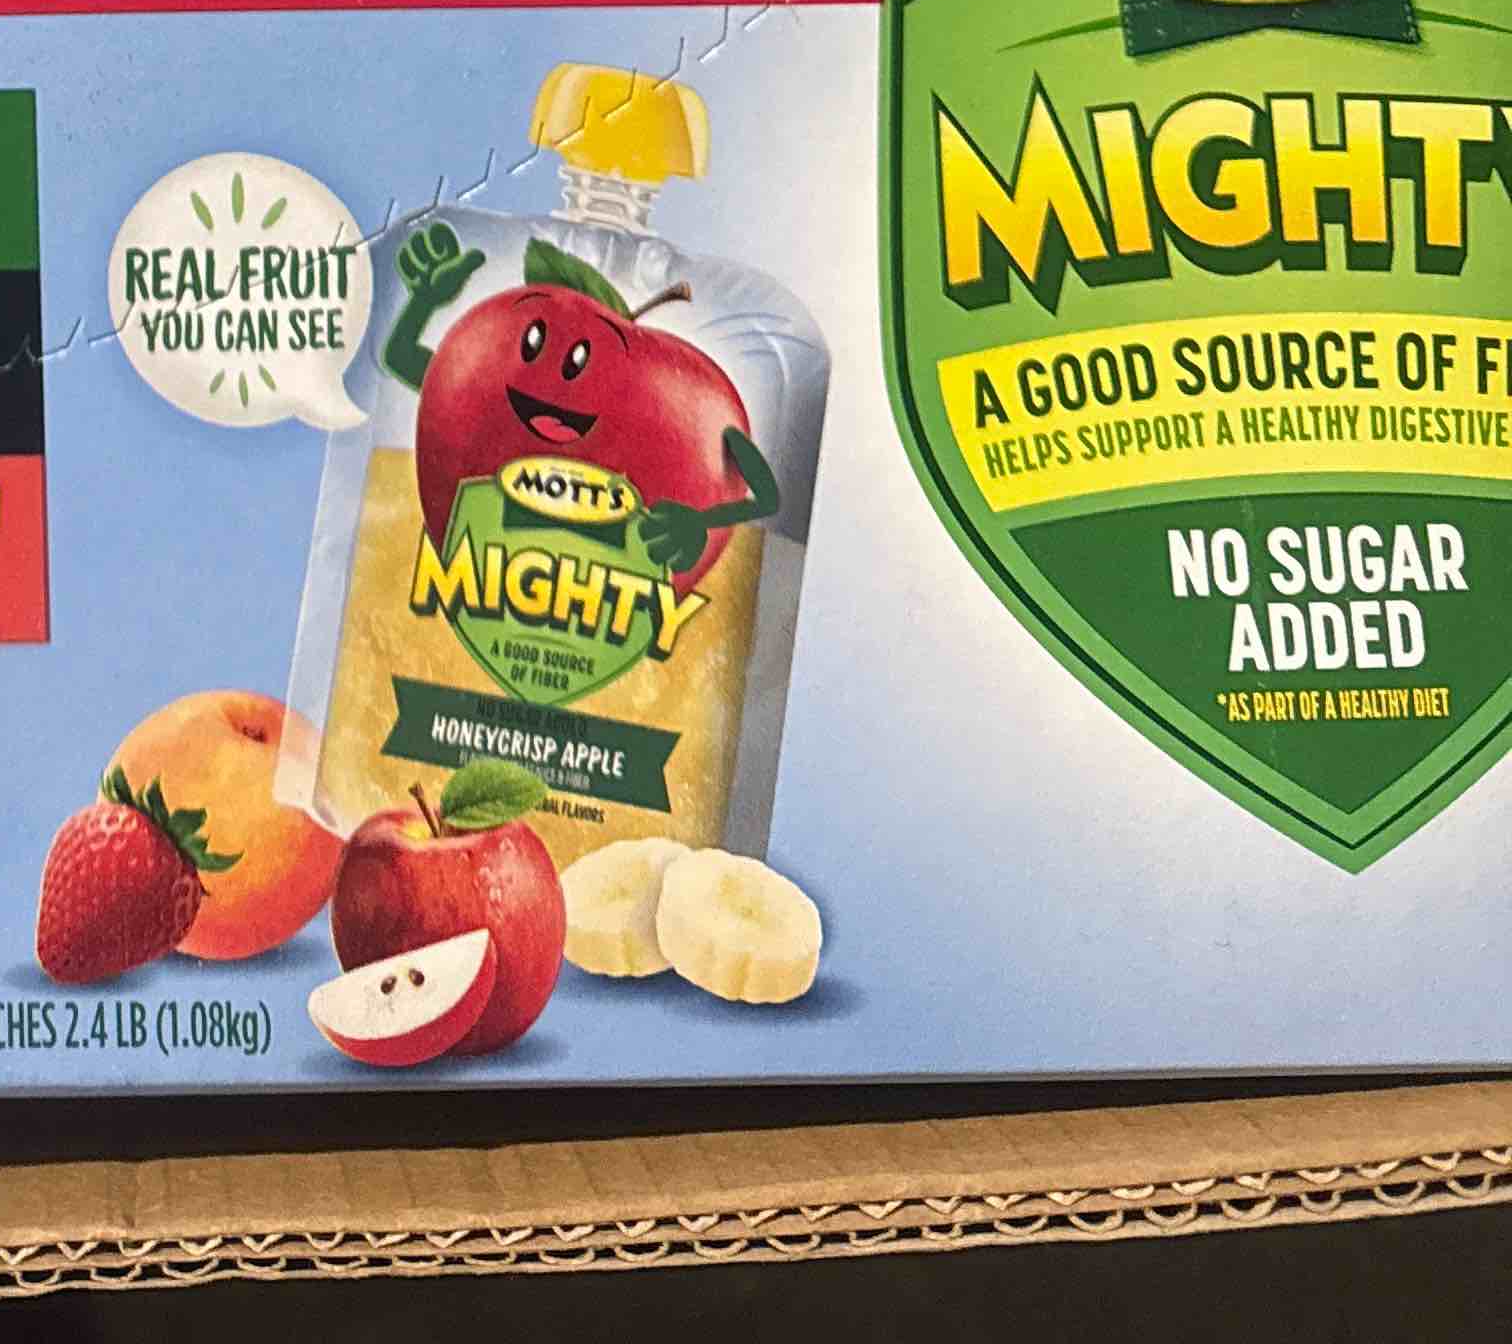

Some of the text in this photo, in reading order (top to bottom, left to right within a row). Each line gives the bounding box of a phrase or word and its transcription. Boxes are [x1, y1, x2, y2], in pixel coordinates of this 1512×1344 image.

[930, 70, 1512, 312] MIGHT
[124, 245, 359, 303] REAL FRUIT
[139, 308, 346, 353] YOU CAN SEE
[973, 368, 1011, 429] A
[1016, 343, 1159, 416] GOOD
[1172, 330, 1380, 395] SOURCE
[1396, 334, 1456, 393] OF
[983, 404, 1510, 479] HELPS SUPPORT A HEALTHY DIGESTIVE
[408, 527, 710, 663] MIGHTY
[1167, 522, 1469, 598] NO SUGAR
[1228, 599, 1427, 673] ADDED
[1253, 691, 1295, 721] PART
[1300, 690, 1320, 720] OF
[1324, 691, 1337, 720] A
[1339, 689, 1410, 719] HEALTHY
[1413, 687, 1450, 718] DIET
[430, 712, 626, 778] HONEYCRISP APPLE
[64, 1000, 108, 1050] 2.4
[114, 1000, 148, 1049] LB
[156, 1000, 272, 1056] (1.08kg)
